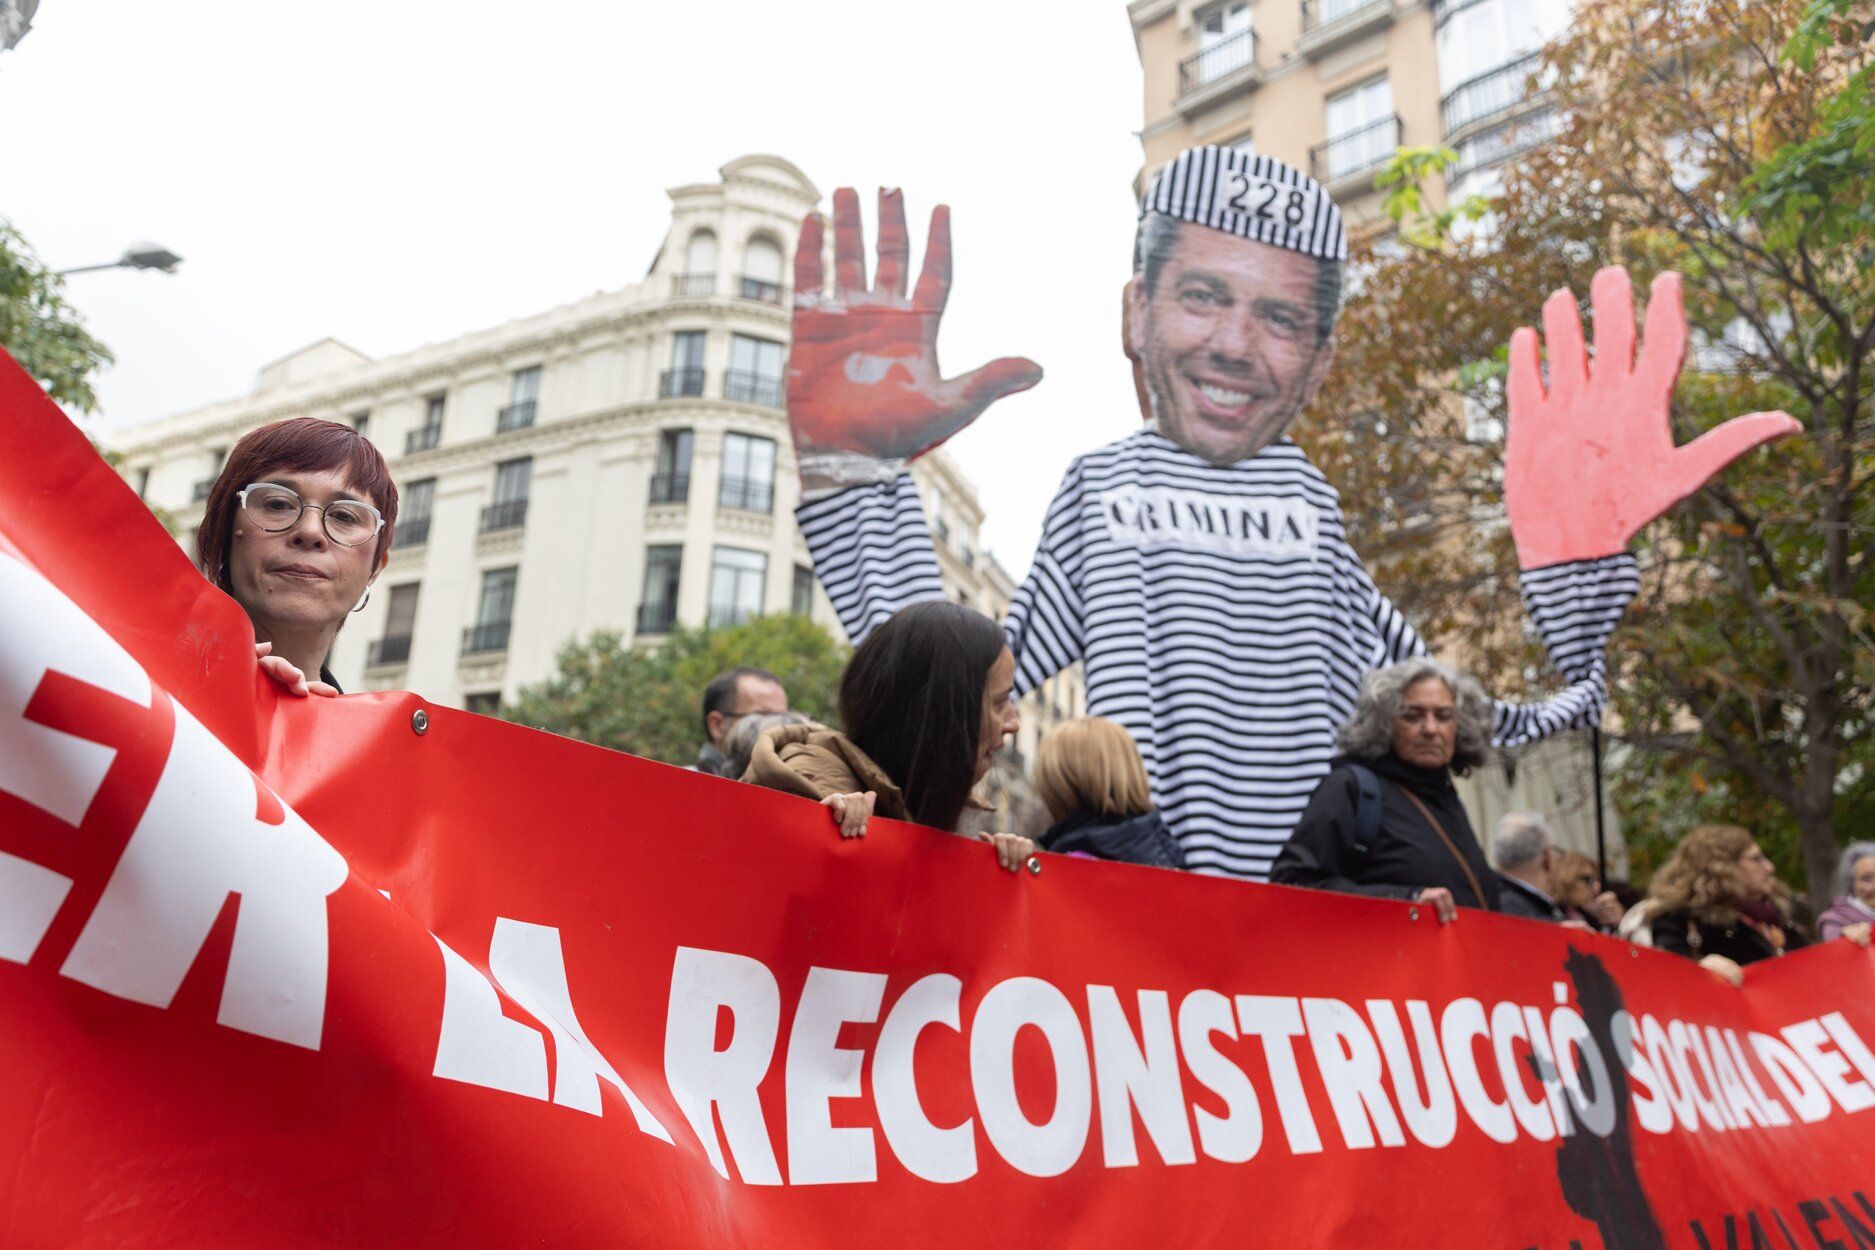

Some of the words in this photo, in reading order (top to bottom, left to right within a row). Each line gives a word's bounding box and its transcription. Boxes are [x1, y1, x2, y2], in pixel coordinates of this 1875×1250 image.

[1229, 174, 1304, 226] 228
[1111, 498, 1312, 540] CRIMINA
[664, 946, 1615, 1186] RECONSTRUCCIÓ
[1611, 1009, 1793, 1134] SOCIAL
